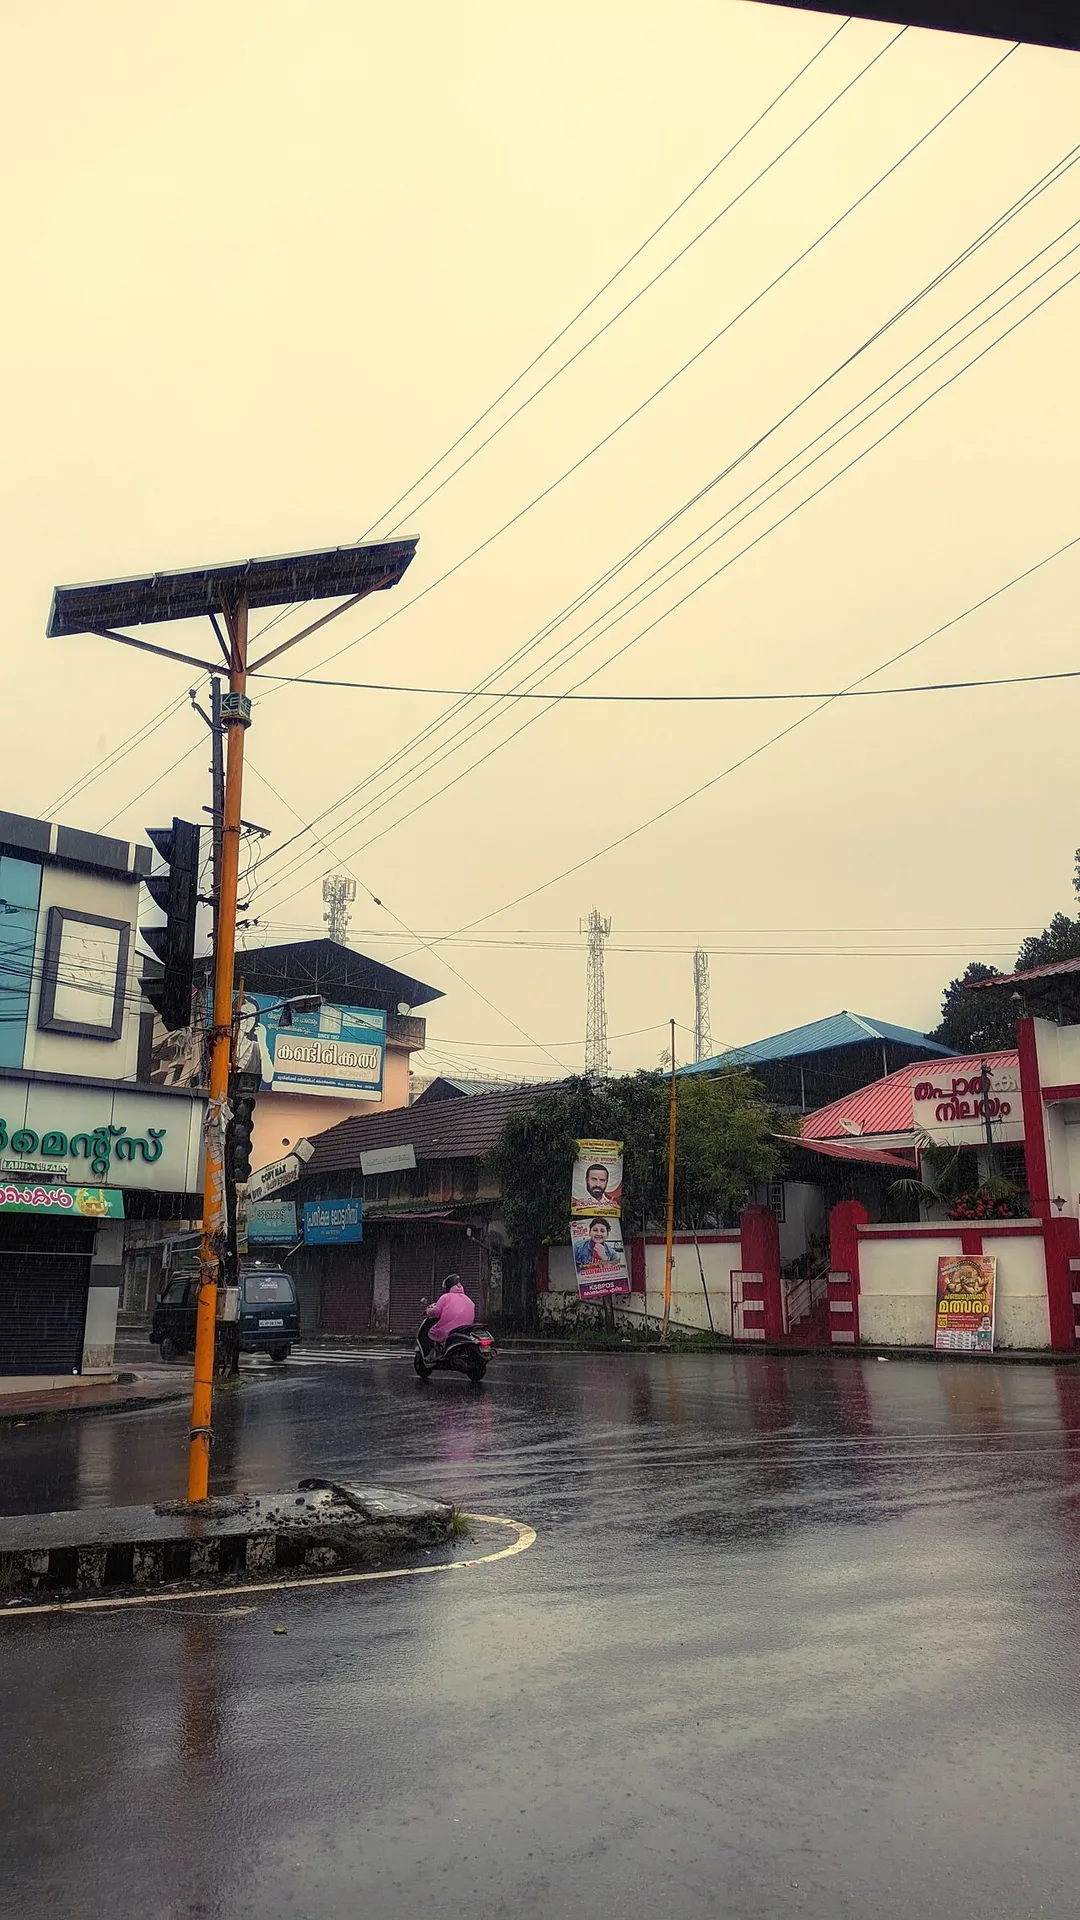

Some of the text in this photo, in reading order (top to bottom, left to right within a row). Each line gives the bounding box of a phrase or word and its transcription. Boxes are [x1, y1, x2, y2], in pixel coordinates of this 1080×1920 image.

[936, 1097, 1011, 1121] നിലയം
[261, 1169, 276, 1183] COPY
[938, 1300, 990, 1314] മത്സരം
